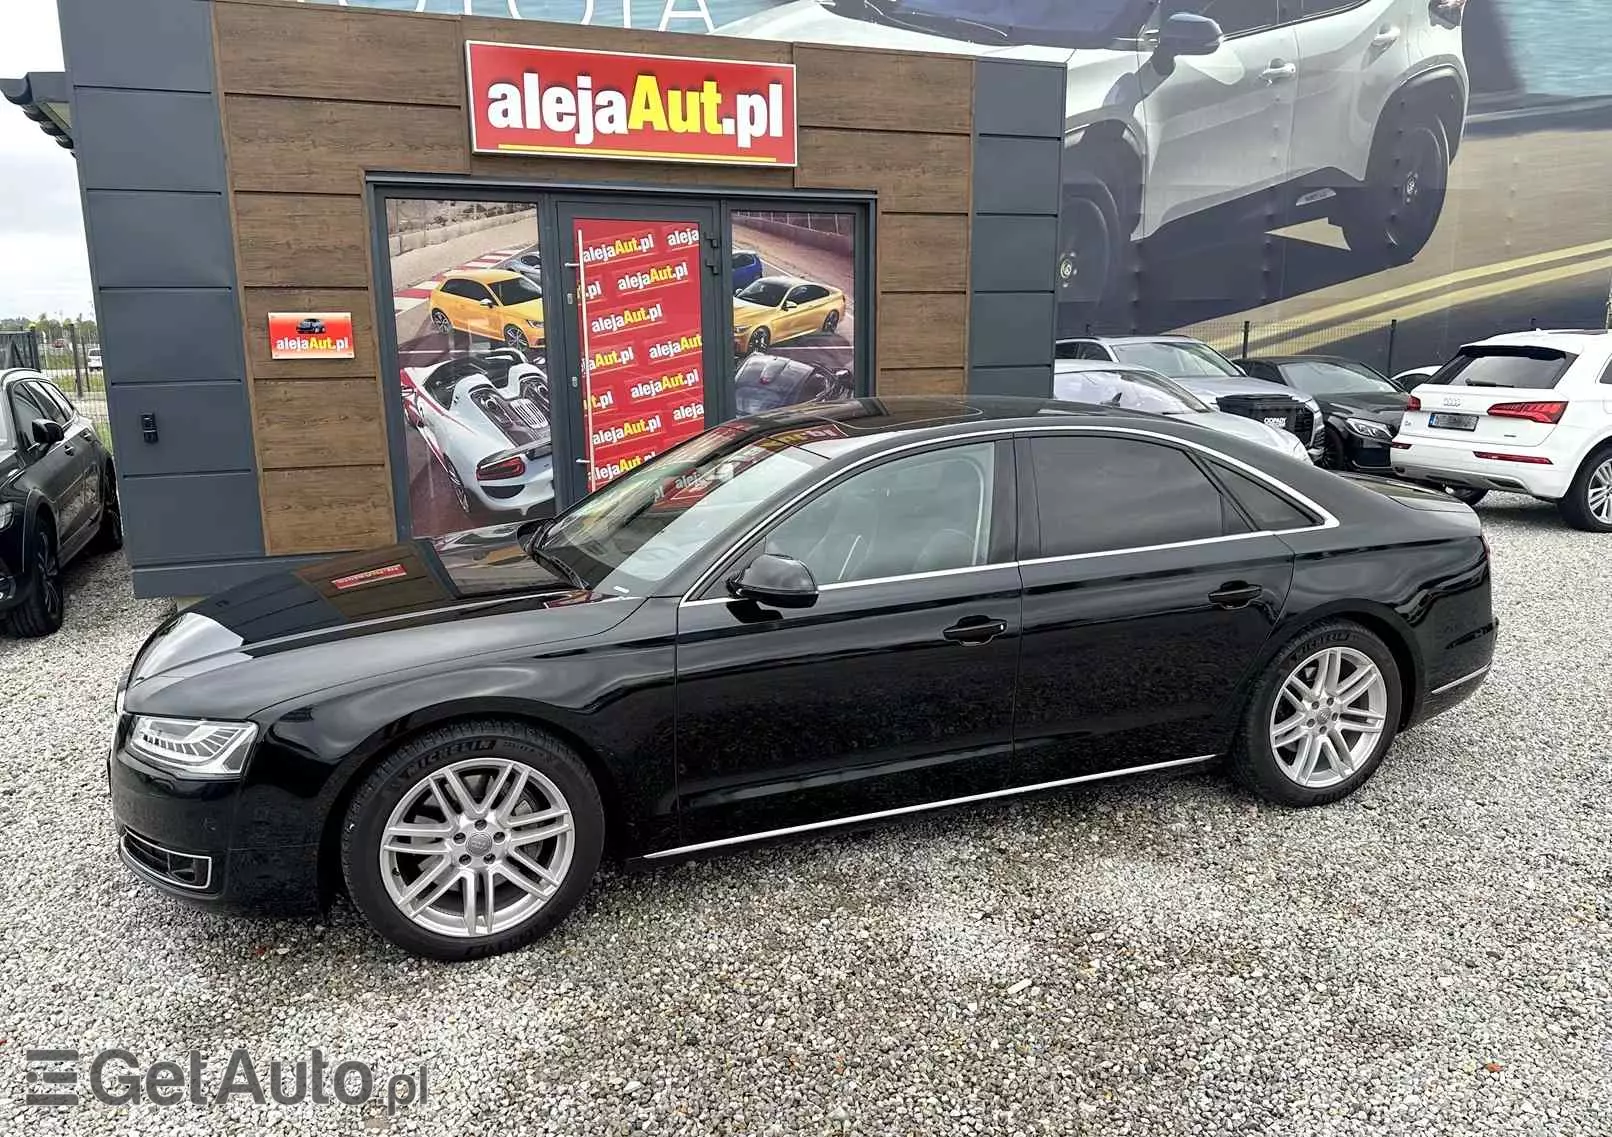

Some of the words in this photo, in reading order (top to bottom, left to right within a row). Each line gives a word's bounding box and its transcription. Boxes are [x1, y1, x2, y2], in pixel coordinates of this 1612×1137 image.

[486, 71, 784, 149] alejaAut.pl
[582, 233, 654, 263] alejaAut.pl
[667, 228, 700, 246] aleja
[617, 262, 689, 291] alejaAut.pl
[591, 303, 663, 333] alejaAut.pl
[276, 336, 349, 353] alejaAut.pl
[648, 333, 703, 359] alejaAut
[630, 368, 700, 399] alejaAut.pl
[672, 402, 704, 421] aleja
[591, 415, 662, 446] alejaAut.pl
